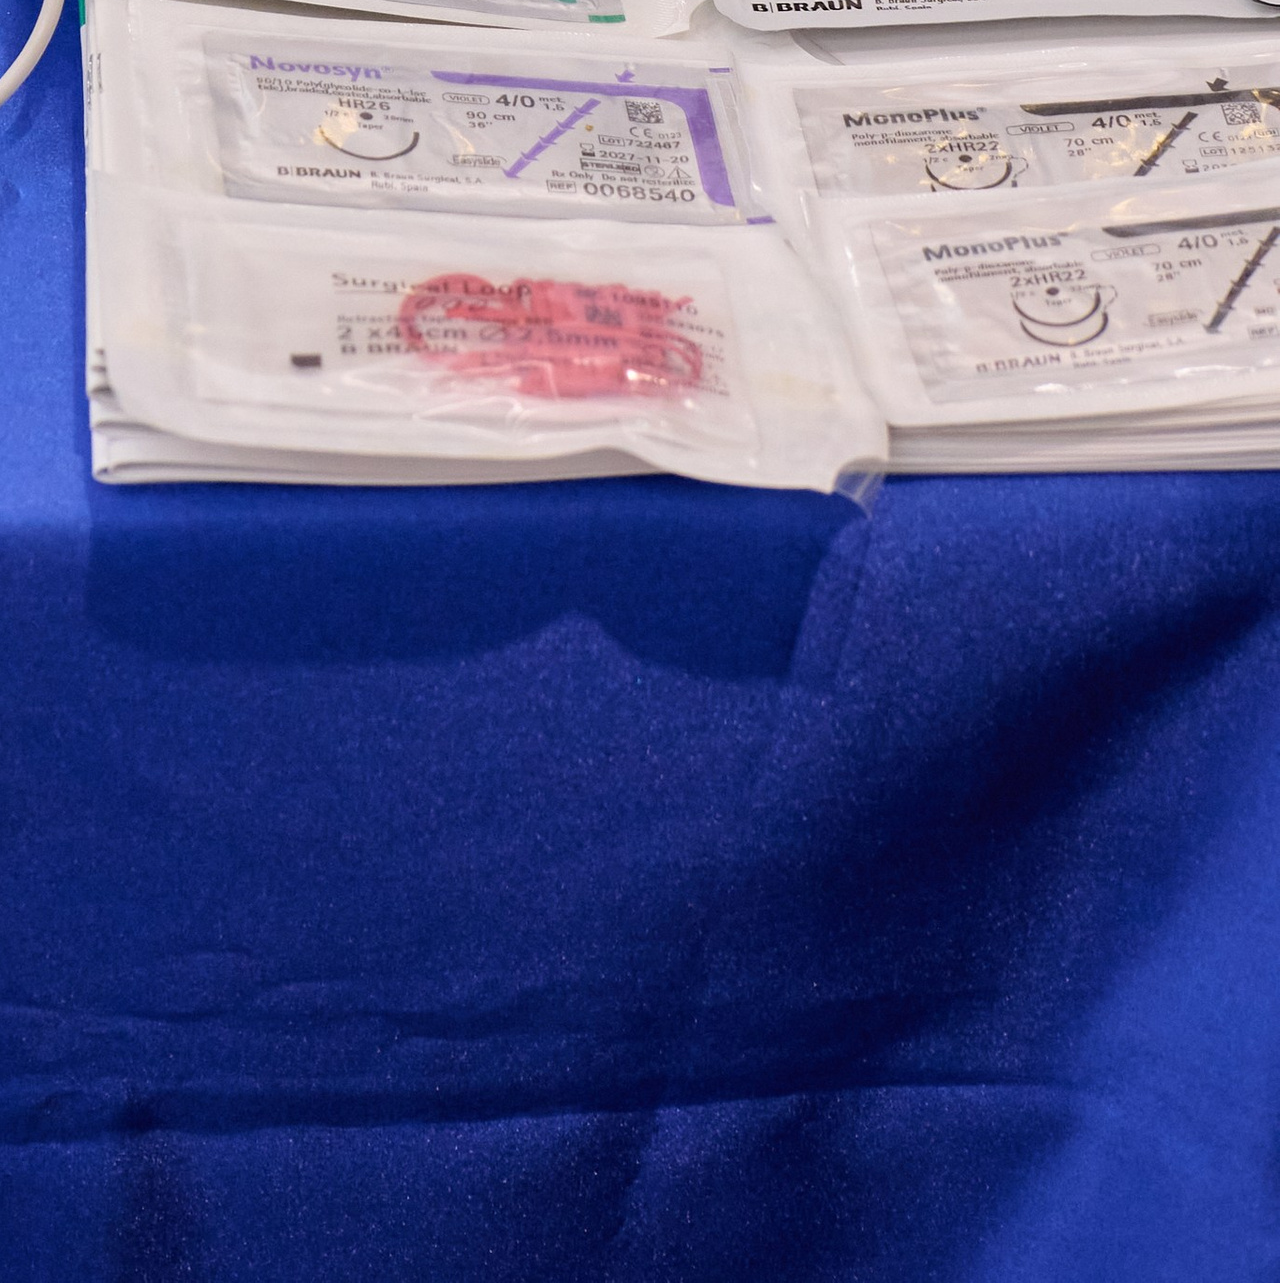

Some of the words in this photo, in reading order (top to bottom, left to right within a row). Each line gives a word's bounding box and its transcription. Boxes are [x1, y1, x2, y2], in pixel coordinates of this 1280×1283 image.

[339, 98, 391, 111] HR26
[449, 95, 484, 103] VIOLET
[496, 94, 535, 108] 4/0
[466, 111, 487, 120] 90
[493, 113, 516, 121] cm
[1092, 114, 1131, 129] 4/0
[1020, 124, 1059, 133] VIOLET
[925, 141, 1000, 154] 2xHR22
[1065, 138, 1084, 147] 70
[1091, 136, 1114, 146] cm
[599, 149, 689, 164] 2027-11-20
[551, 170, 565, 178] Rx
[569, 171, 594, 182] Only
[601, 173, 616, 181] Do
[621, 175, 639, 183] not
[584, 182, 695, 203] 0068540
[1178, 234, 1218, 250] 4/0
[1153, 262, 1172, 271] 70
[1179, 258, 1202, 268] cm
[1010, 269, 1087, 288] 2xHR22
